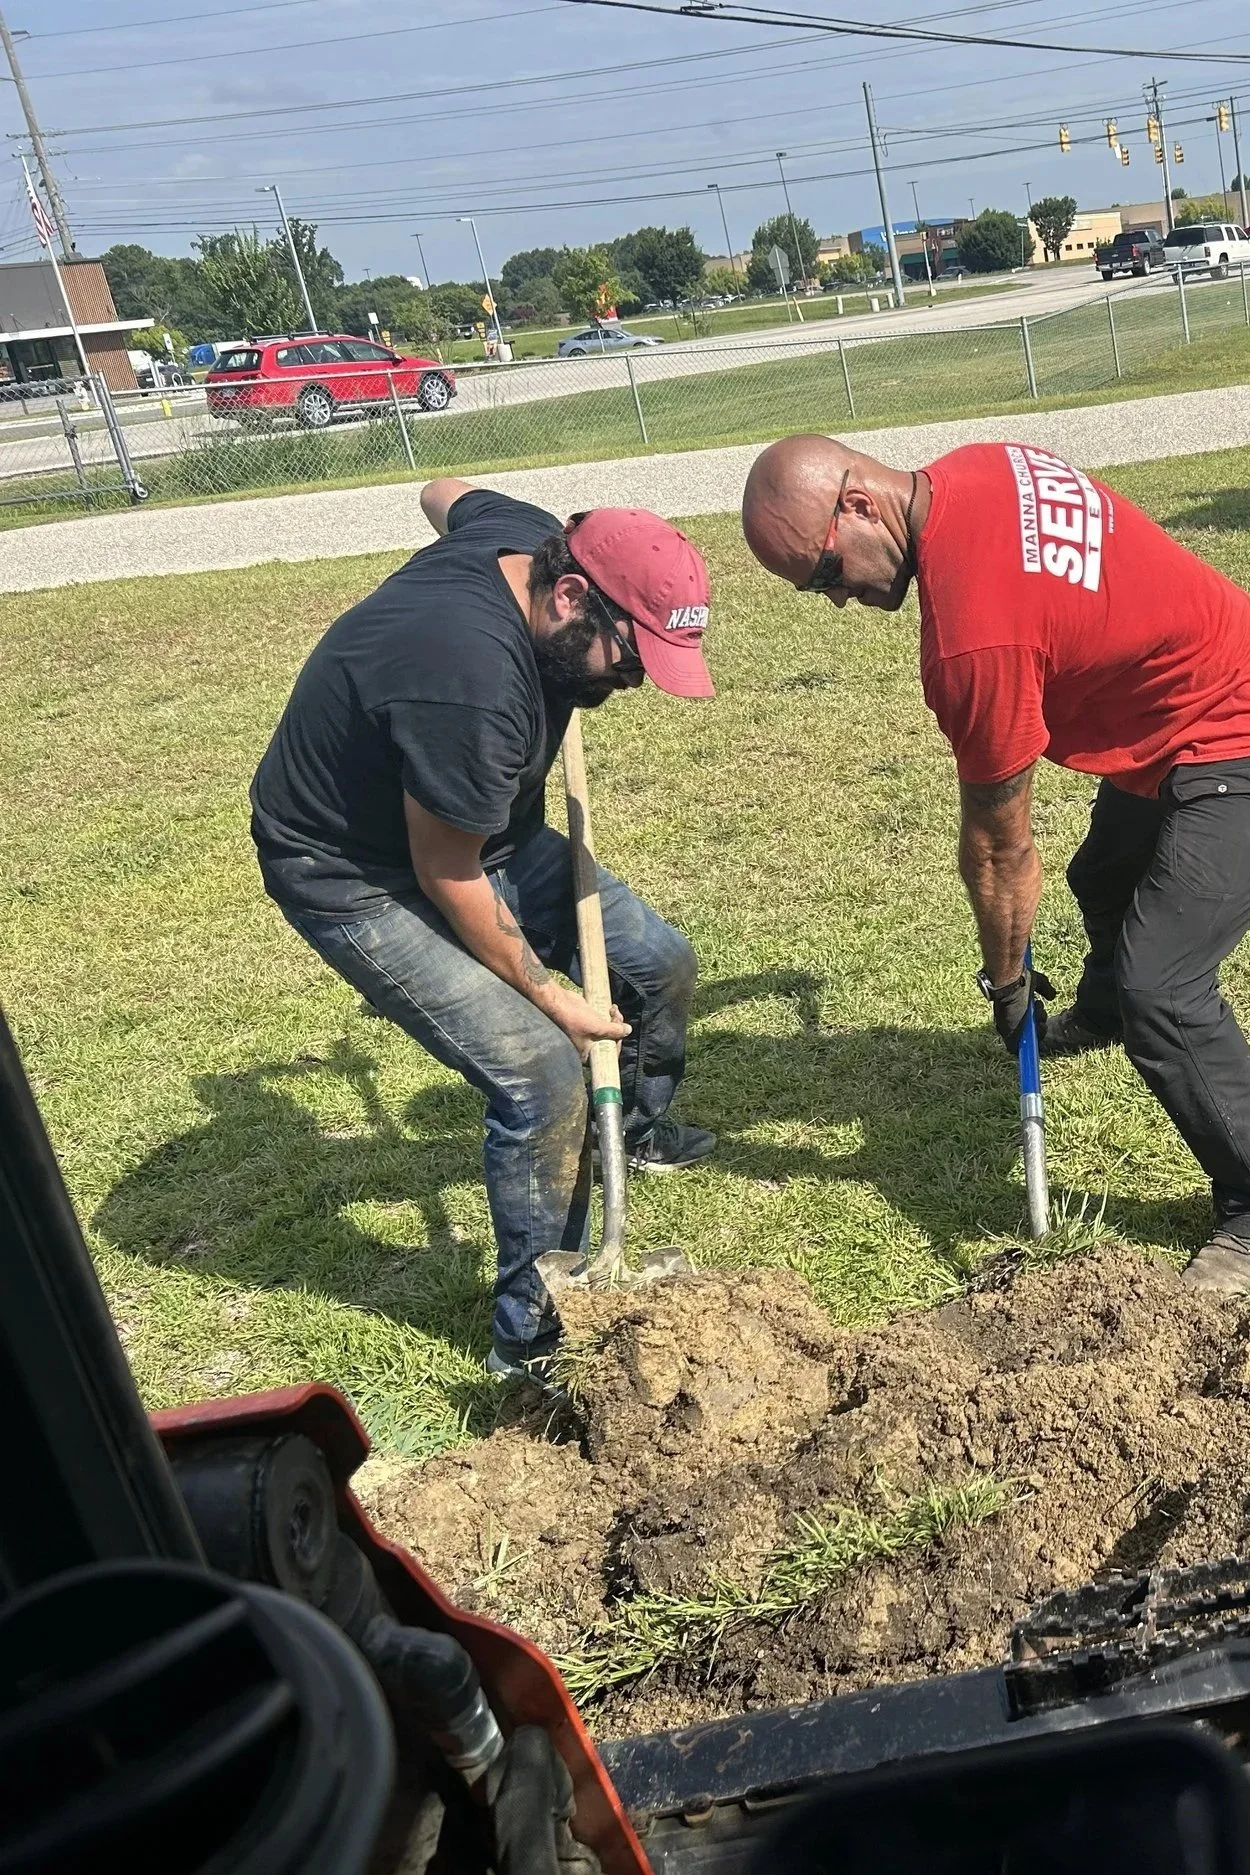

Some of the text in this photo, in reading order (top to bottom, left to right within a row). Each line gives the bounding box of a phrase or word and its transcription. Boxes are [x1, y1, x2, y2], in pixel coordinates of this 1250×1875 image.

[1010, 448, 1039, 564] MANNA CHURCH
[1024, 448, 1083, 585] SERVE
